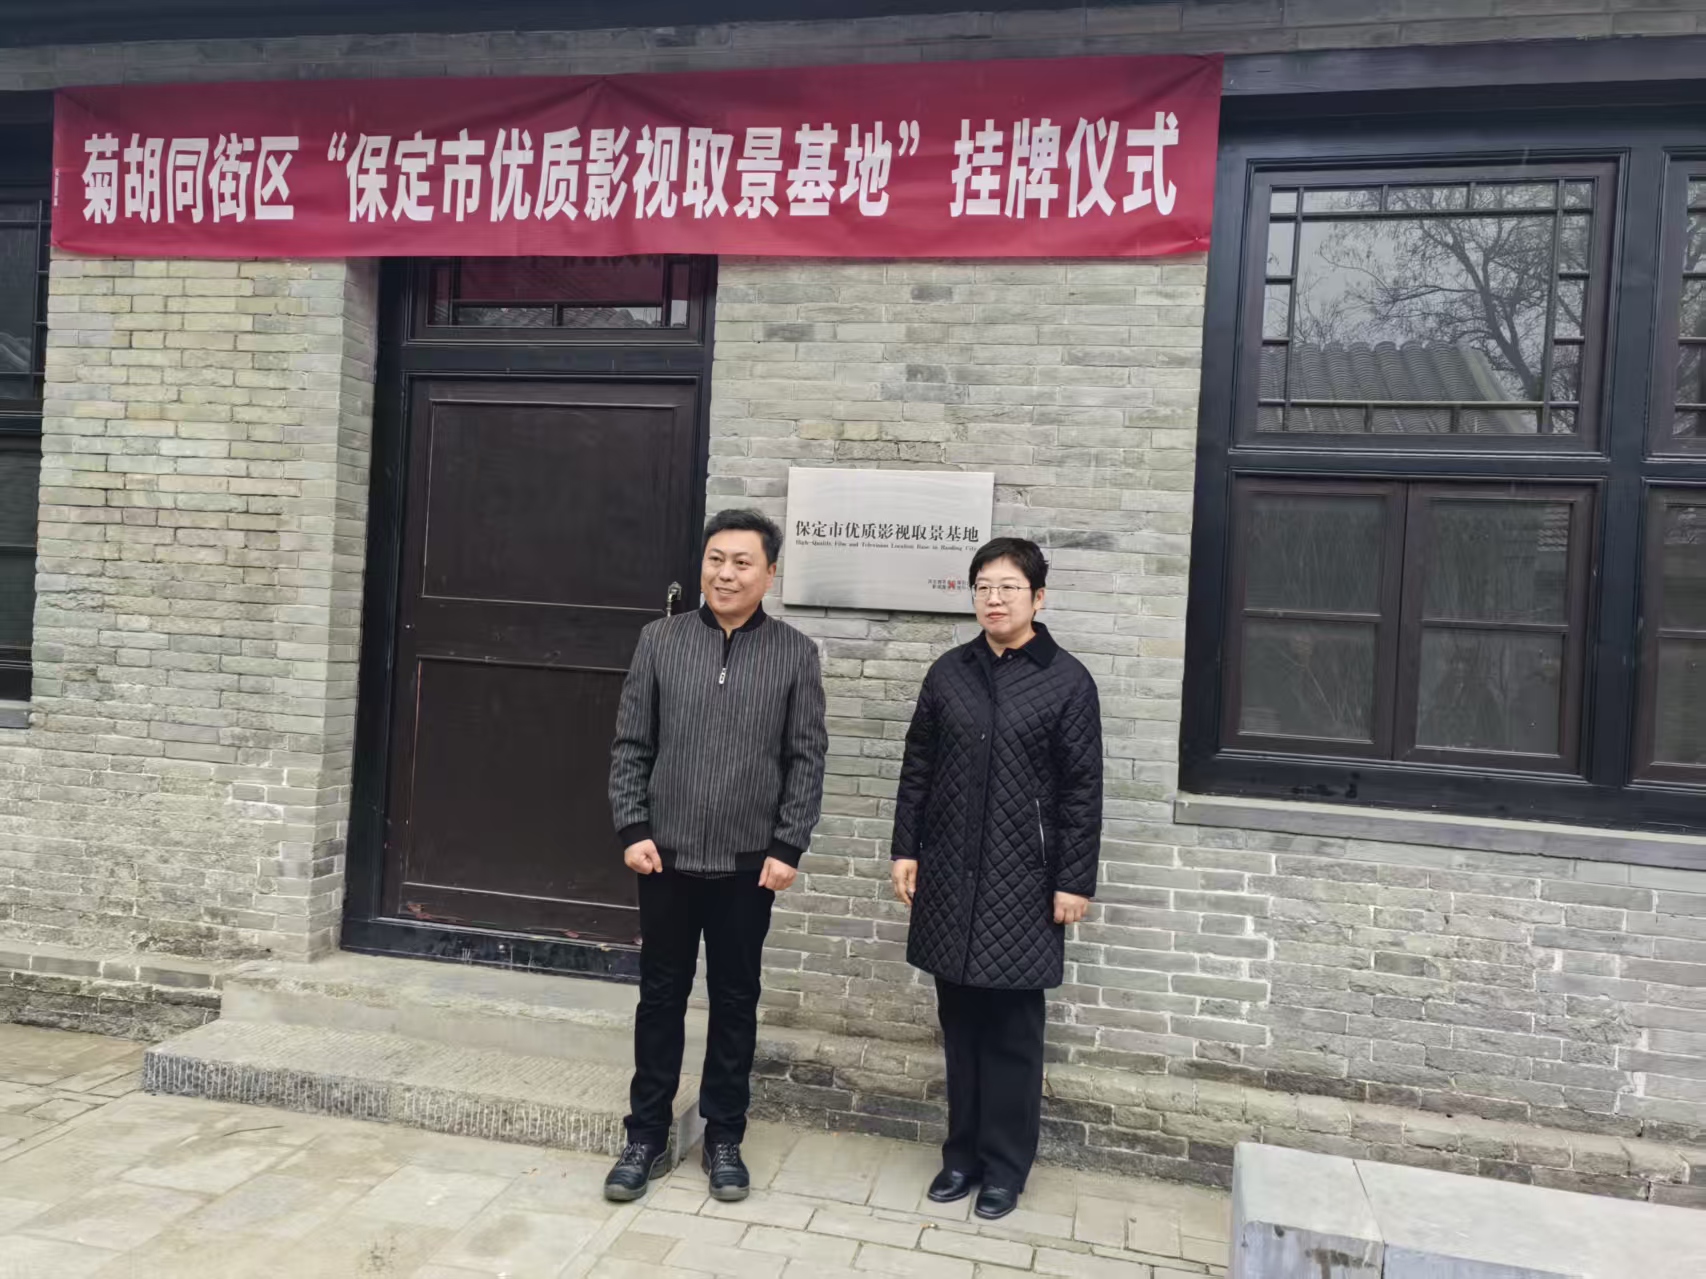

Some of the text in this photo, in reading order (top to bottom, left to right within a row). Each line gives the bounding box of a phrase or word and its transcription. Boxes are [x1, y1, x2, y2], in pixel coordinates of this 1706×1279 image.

[81, 132, 299, 224] 菊胡同街区
[950, 111, 1179, 219] 挂牌仪式
[796, 520, 979, 543] 保定市优质影视取景基地
